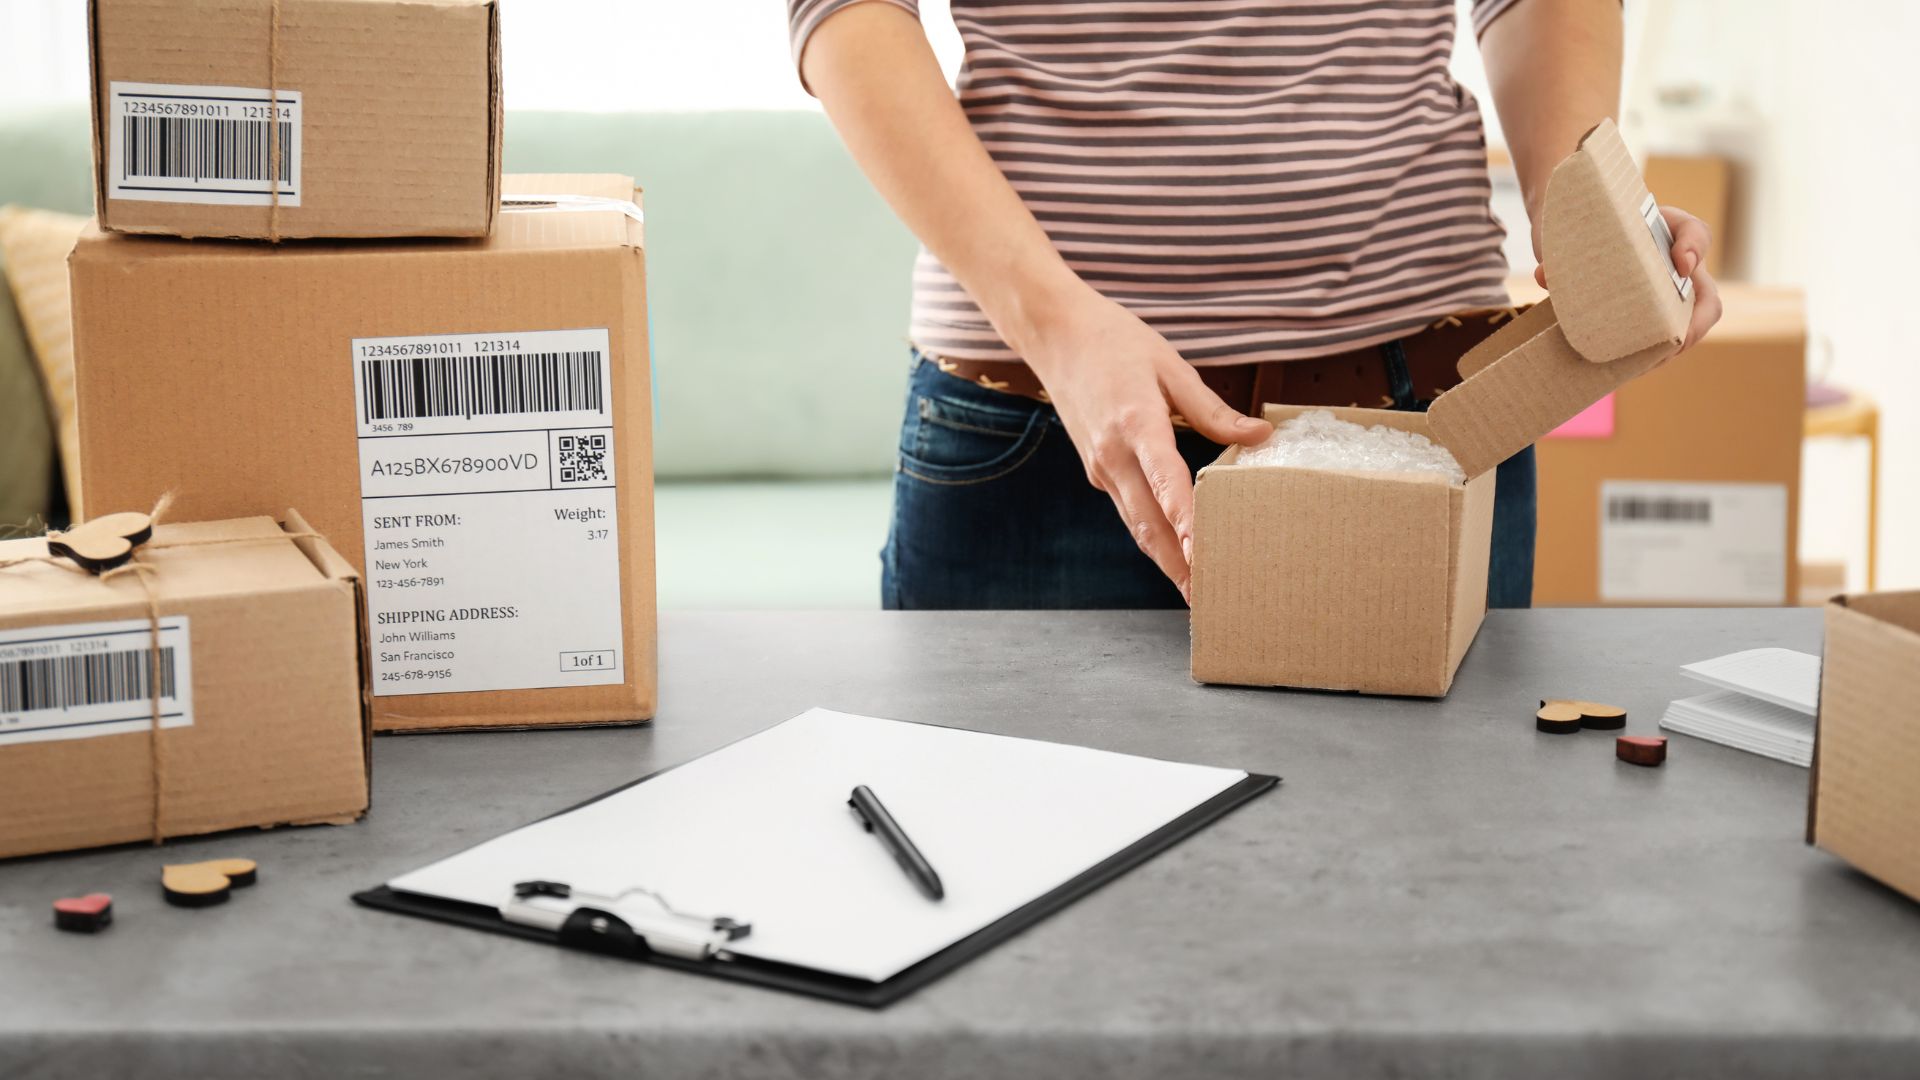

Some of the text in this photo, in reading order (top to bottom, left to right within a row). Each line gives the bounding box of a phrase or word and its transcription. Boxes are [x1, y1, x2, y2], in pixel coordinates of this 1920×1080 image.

[124, 101, 291, 118] 1234567891011 121314
[361, 340, 520, 357] 1234567891011 121314
[372, 423, 413, 432] 3456 789
[371, 453, 538, 477] A125BX678900VD
[374, 513, 461, 529] SENT FROM:
[554, 508, 606, 522] Weight:
[587, 529, 608, 540] 3.17
[374, 537, 444, 550] James Smith
[376, 558, 428, 570] New York
[376, 577, 445, 588] 123-456-7891
[378, 607, 519, 624] SHIPPING ADDRESS:
[380, 631, 456, 643] John Williams
[381, 650, 454, 662] San Francisco
[597, 655, 603, 665] 1
[382, 669, 452, 681] 245-678-9156
